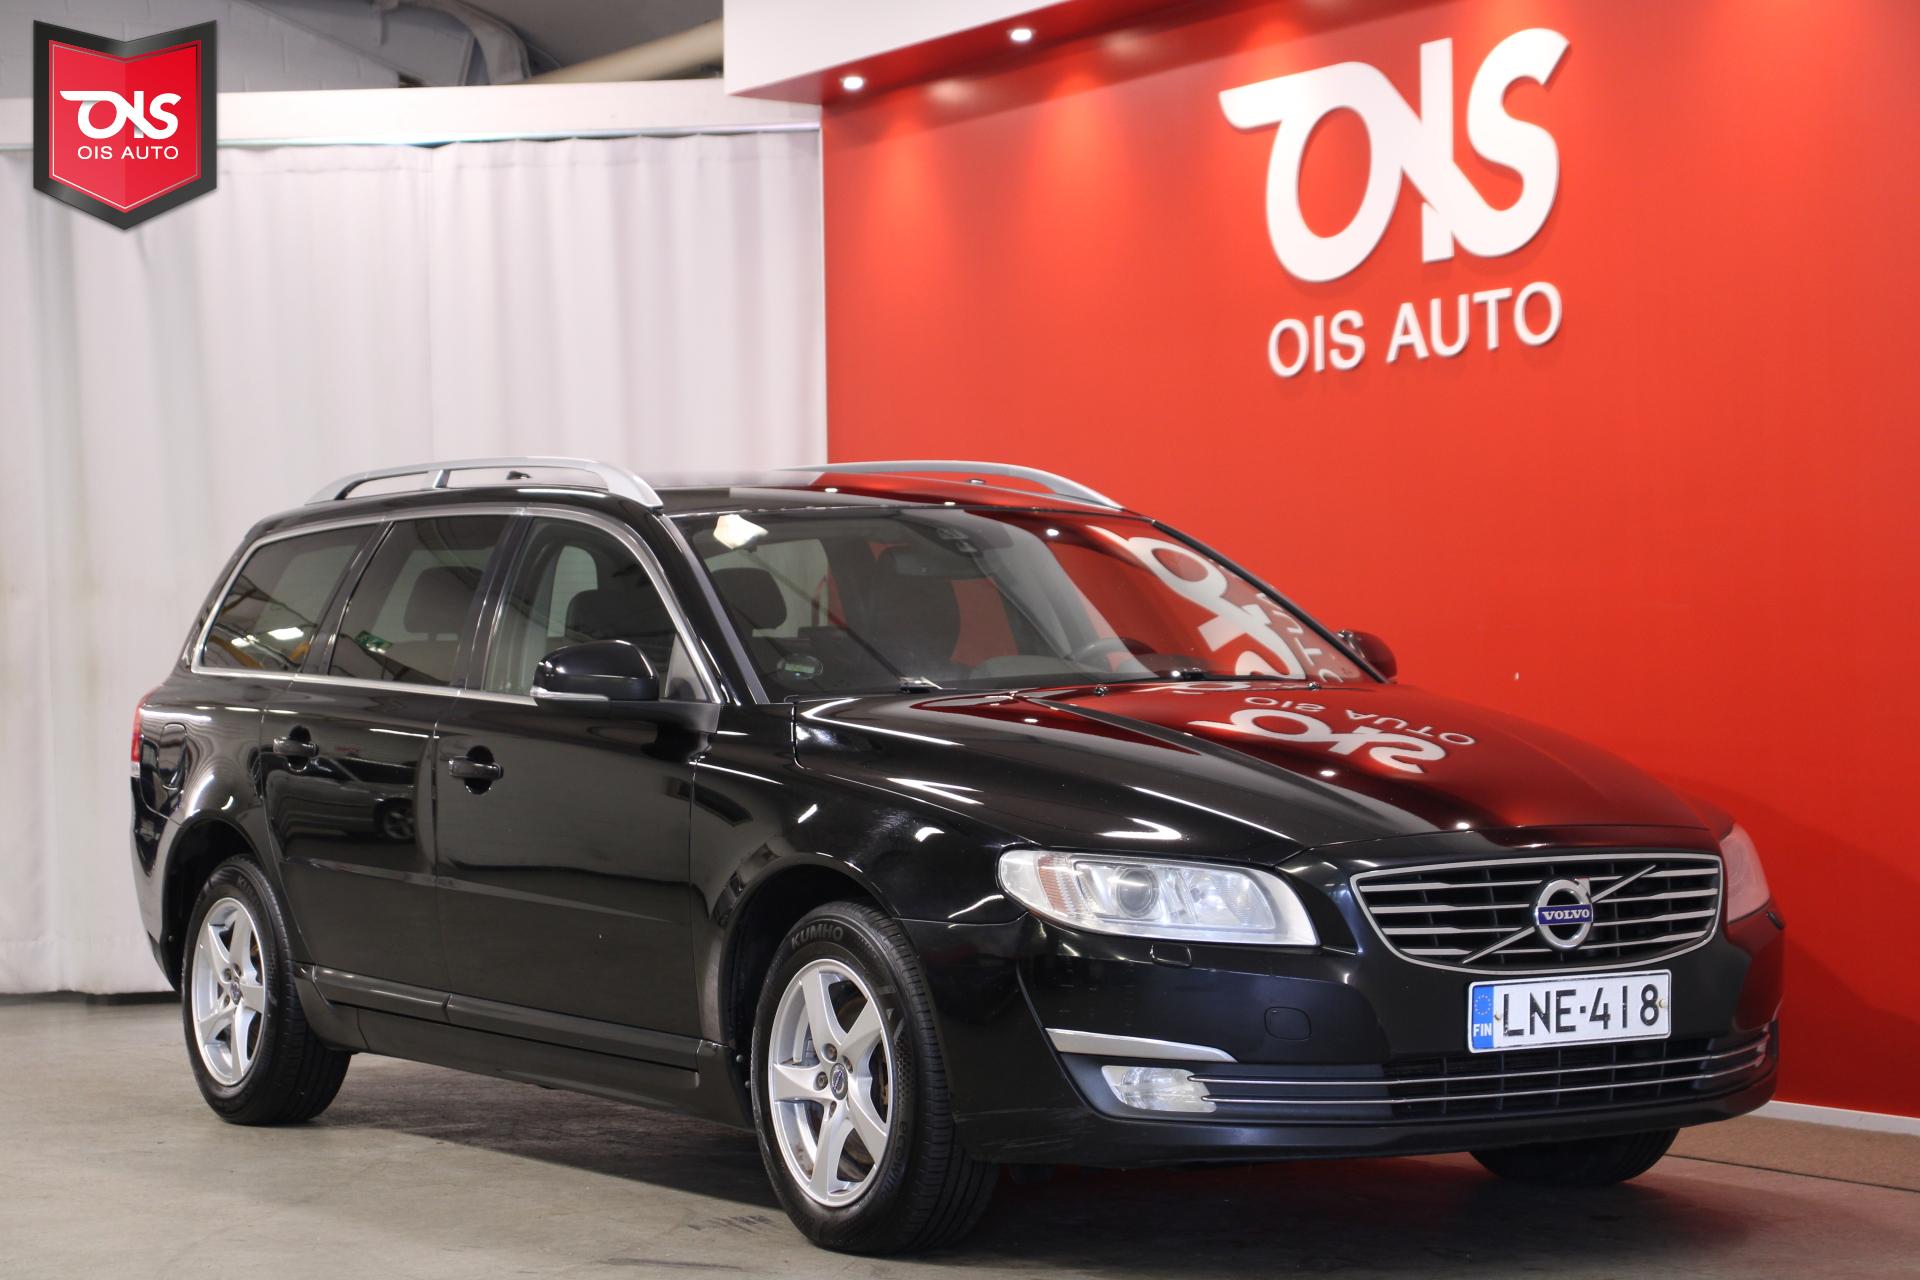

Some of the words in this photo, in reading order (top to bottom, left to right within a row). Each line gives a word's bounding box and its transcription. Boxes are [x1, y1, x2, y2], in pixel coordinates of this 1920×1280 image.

[1218, 27, 1571, 283] OIS
[1267, 309, 1366, 378] OIS
[1386, 281, 1563, 363] AUTO
[1541, 908, 1590, 921] VOLVO
[791, 922, 844, 951] KUMHO
[1473, 1022, 1493, 1038] FIN
